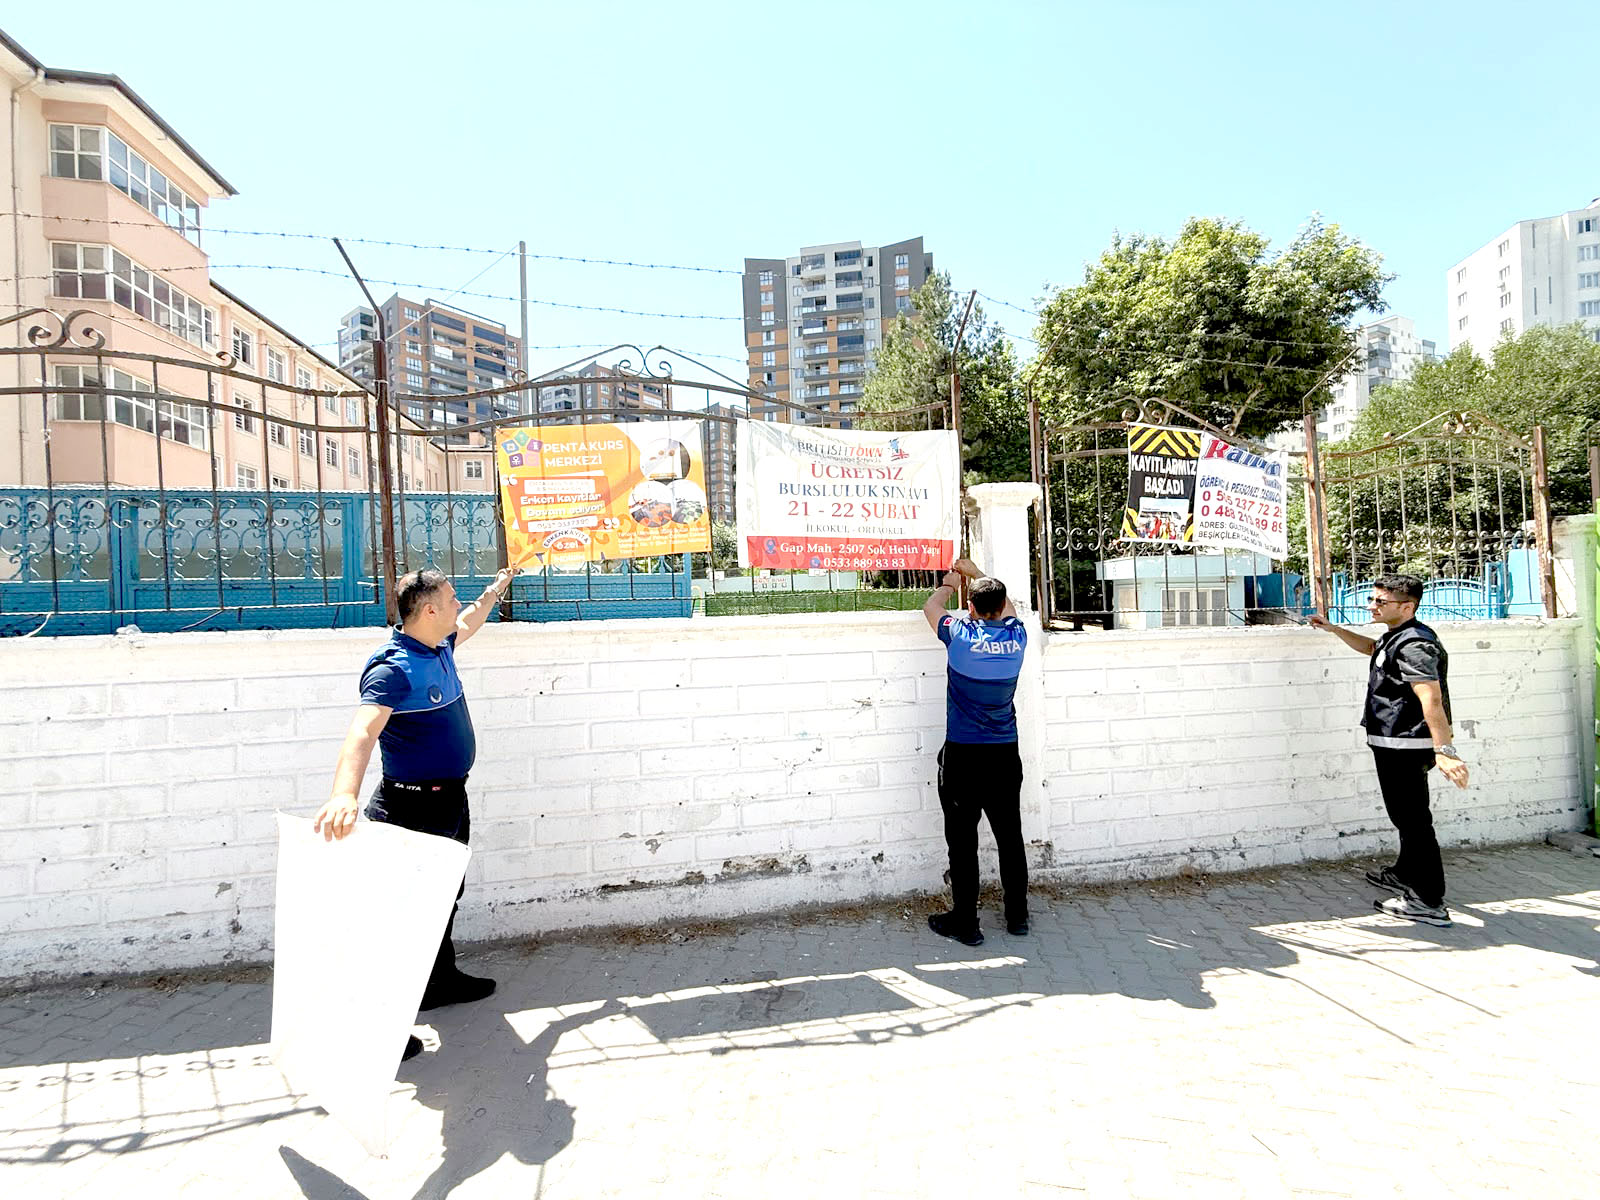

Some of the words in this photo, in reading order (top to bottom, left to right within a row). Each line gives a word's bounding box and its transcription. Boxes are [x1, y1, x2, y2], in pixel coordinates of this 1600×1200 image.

[545, 453, 602, 468] MERKEZİ
[811, 460, 903, 480] ÜCRETSİZ
[779, 483, 878, 497] BURSLULUK
[882, 486, 928, 500] SINAVI
[1144, 476, 1184, 498] BAŞLADI
[520, 496, 554, 505] Erken
[788, 500, 809, 516] 21
[831, 502, 854, 517] 22
[861, 503, 920, 521] ŞUBAT
[780, 543, 803, 555] Gap
[807, 543, 835, 553] Mah.
[839, 544, 865, 554] 2507
[868, 545, 885, 555] Sok
[889, 544, 918, 554] Helin
[824, 558, 850, 568] 0533
[853, 558, 872, 568] 889
[876, 558, 889, 568] 83
[892, 558, 905, 568] 83
[970, 639, 1021, 654] ZABITA
